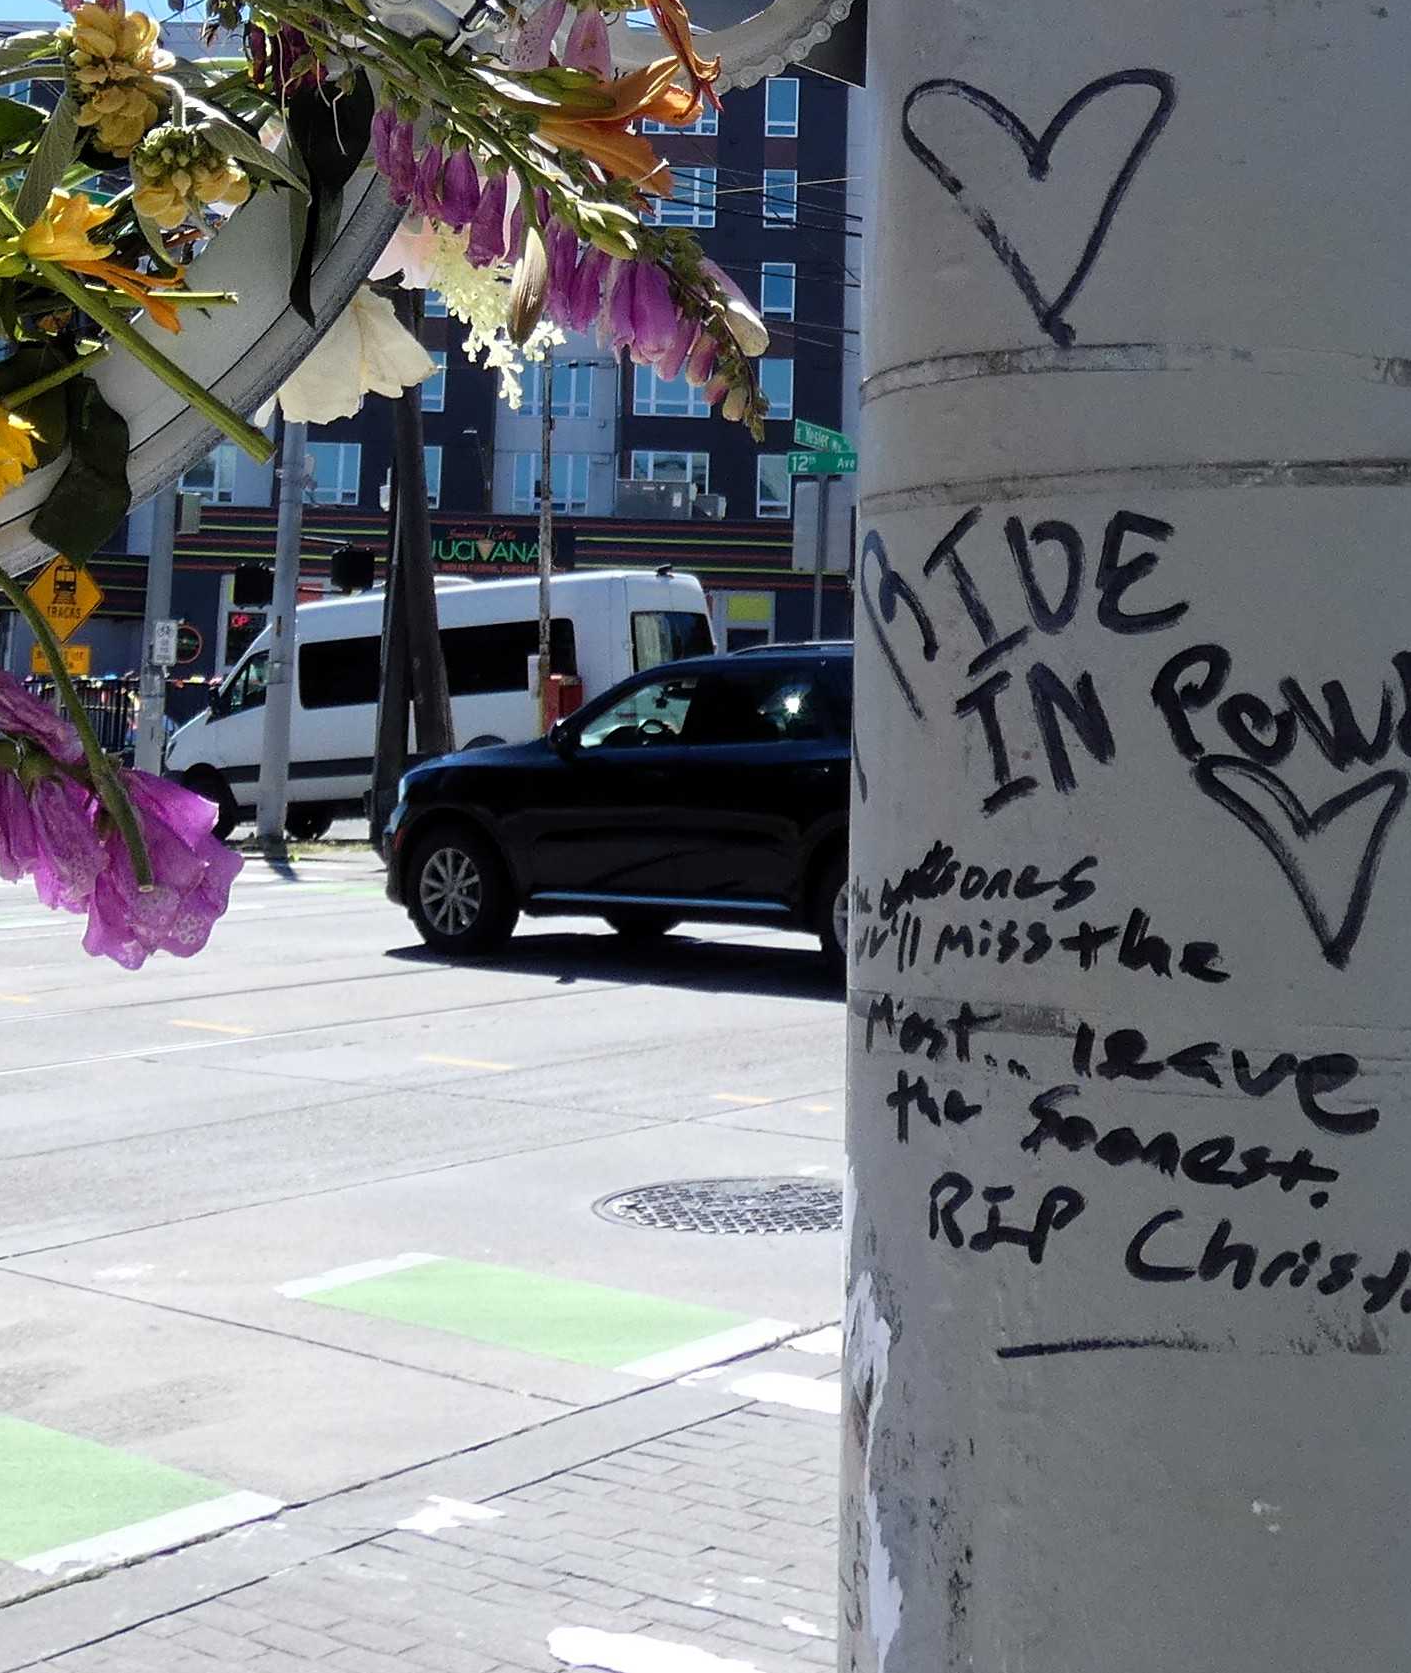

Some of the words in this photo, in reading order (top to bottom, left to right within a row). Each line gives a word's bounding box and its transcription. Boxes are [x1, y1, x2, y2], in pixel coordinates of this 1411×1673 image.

[791, 454, 817, 472] 12th
[836, 457, 856, 470] Ave
[860, 508, 1191, 721] RIDE
[954, 660, 1117, 818] IN
[1058, 907, 1232, 984] the
[886, 1068, 983, 1145] the
[1072, 1021, 1380, 1135] leave
[929, 1171, 1086, 1264] RIP
